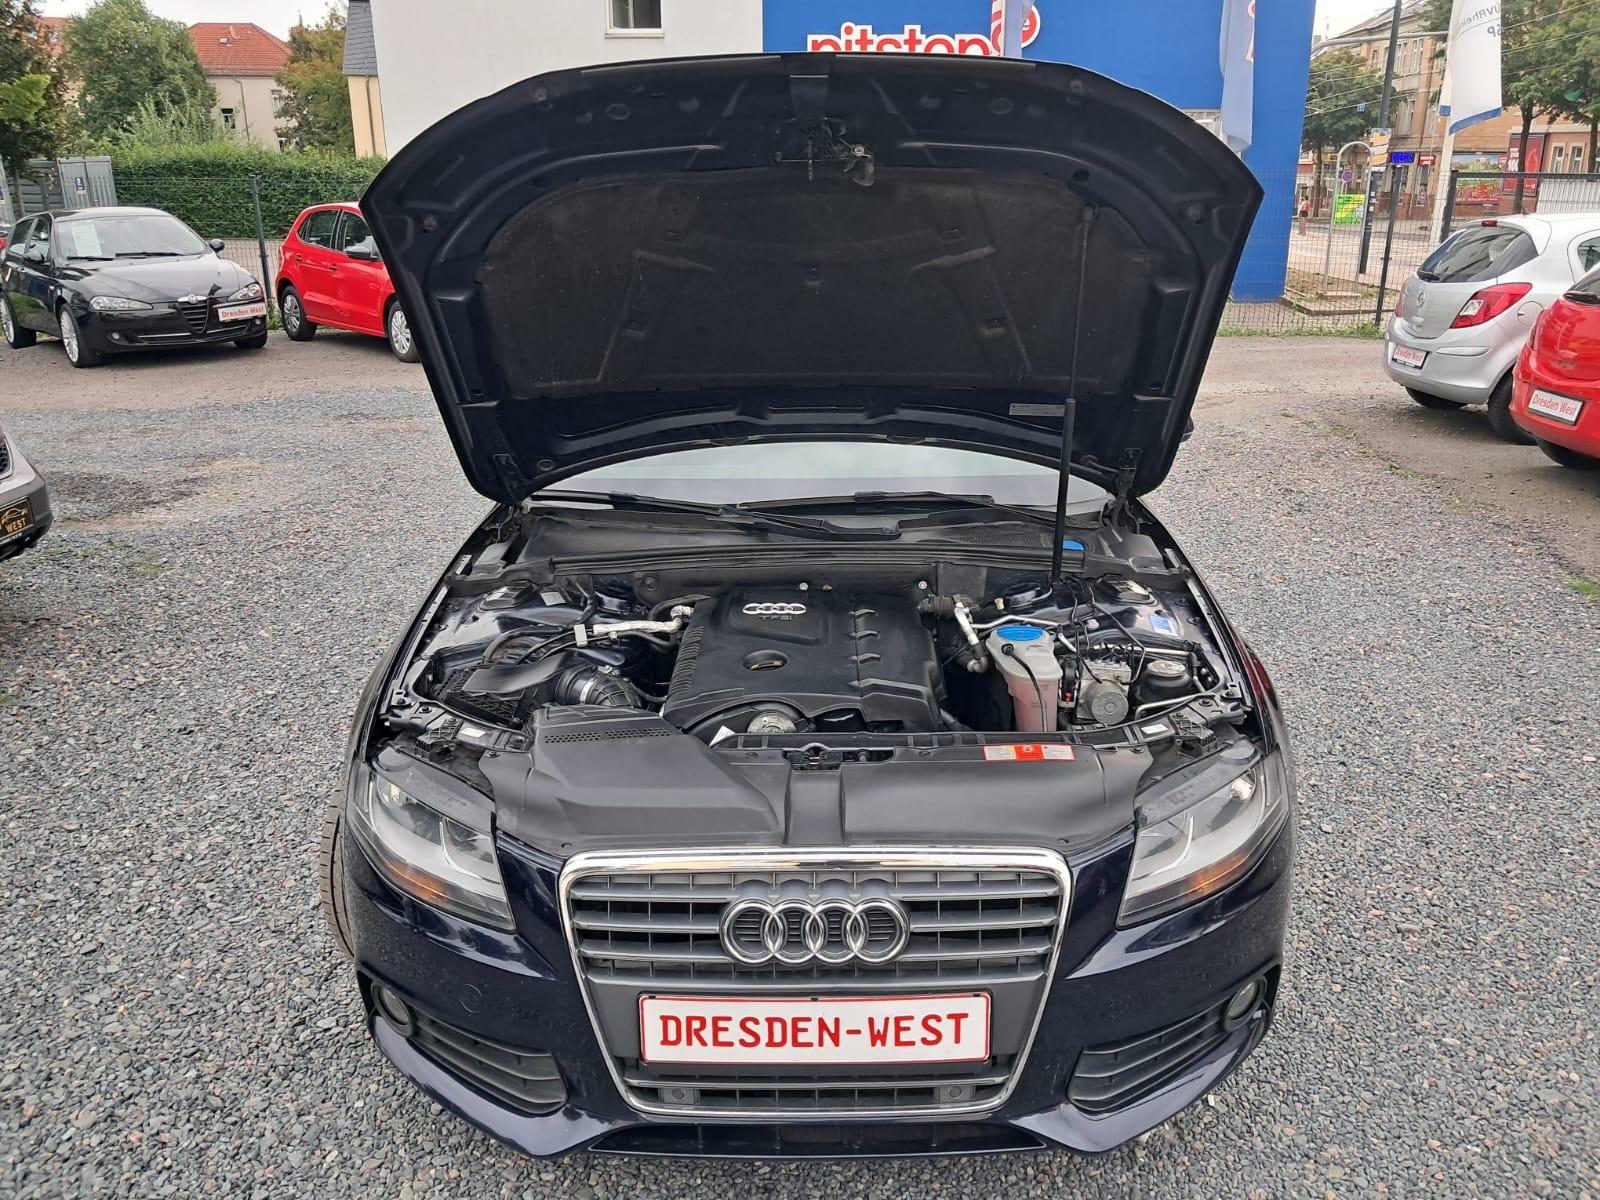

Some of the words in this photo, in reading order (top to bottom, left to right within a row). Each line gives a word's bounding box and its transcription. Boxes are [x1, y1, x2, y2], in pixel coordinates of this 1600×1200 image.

[1532, 394, 1559, 411] Dresden
[1559, 401, 1577, 416] West
[5, 517, 26, 533] WEST
[659, 1013, 969, 1048] DRESDEN-WEST
